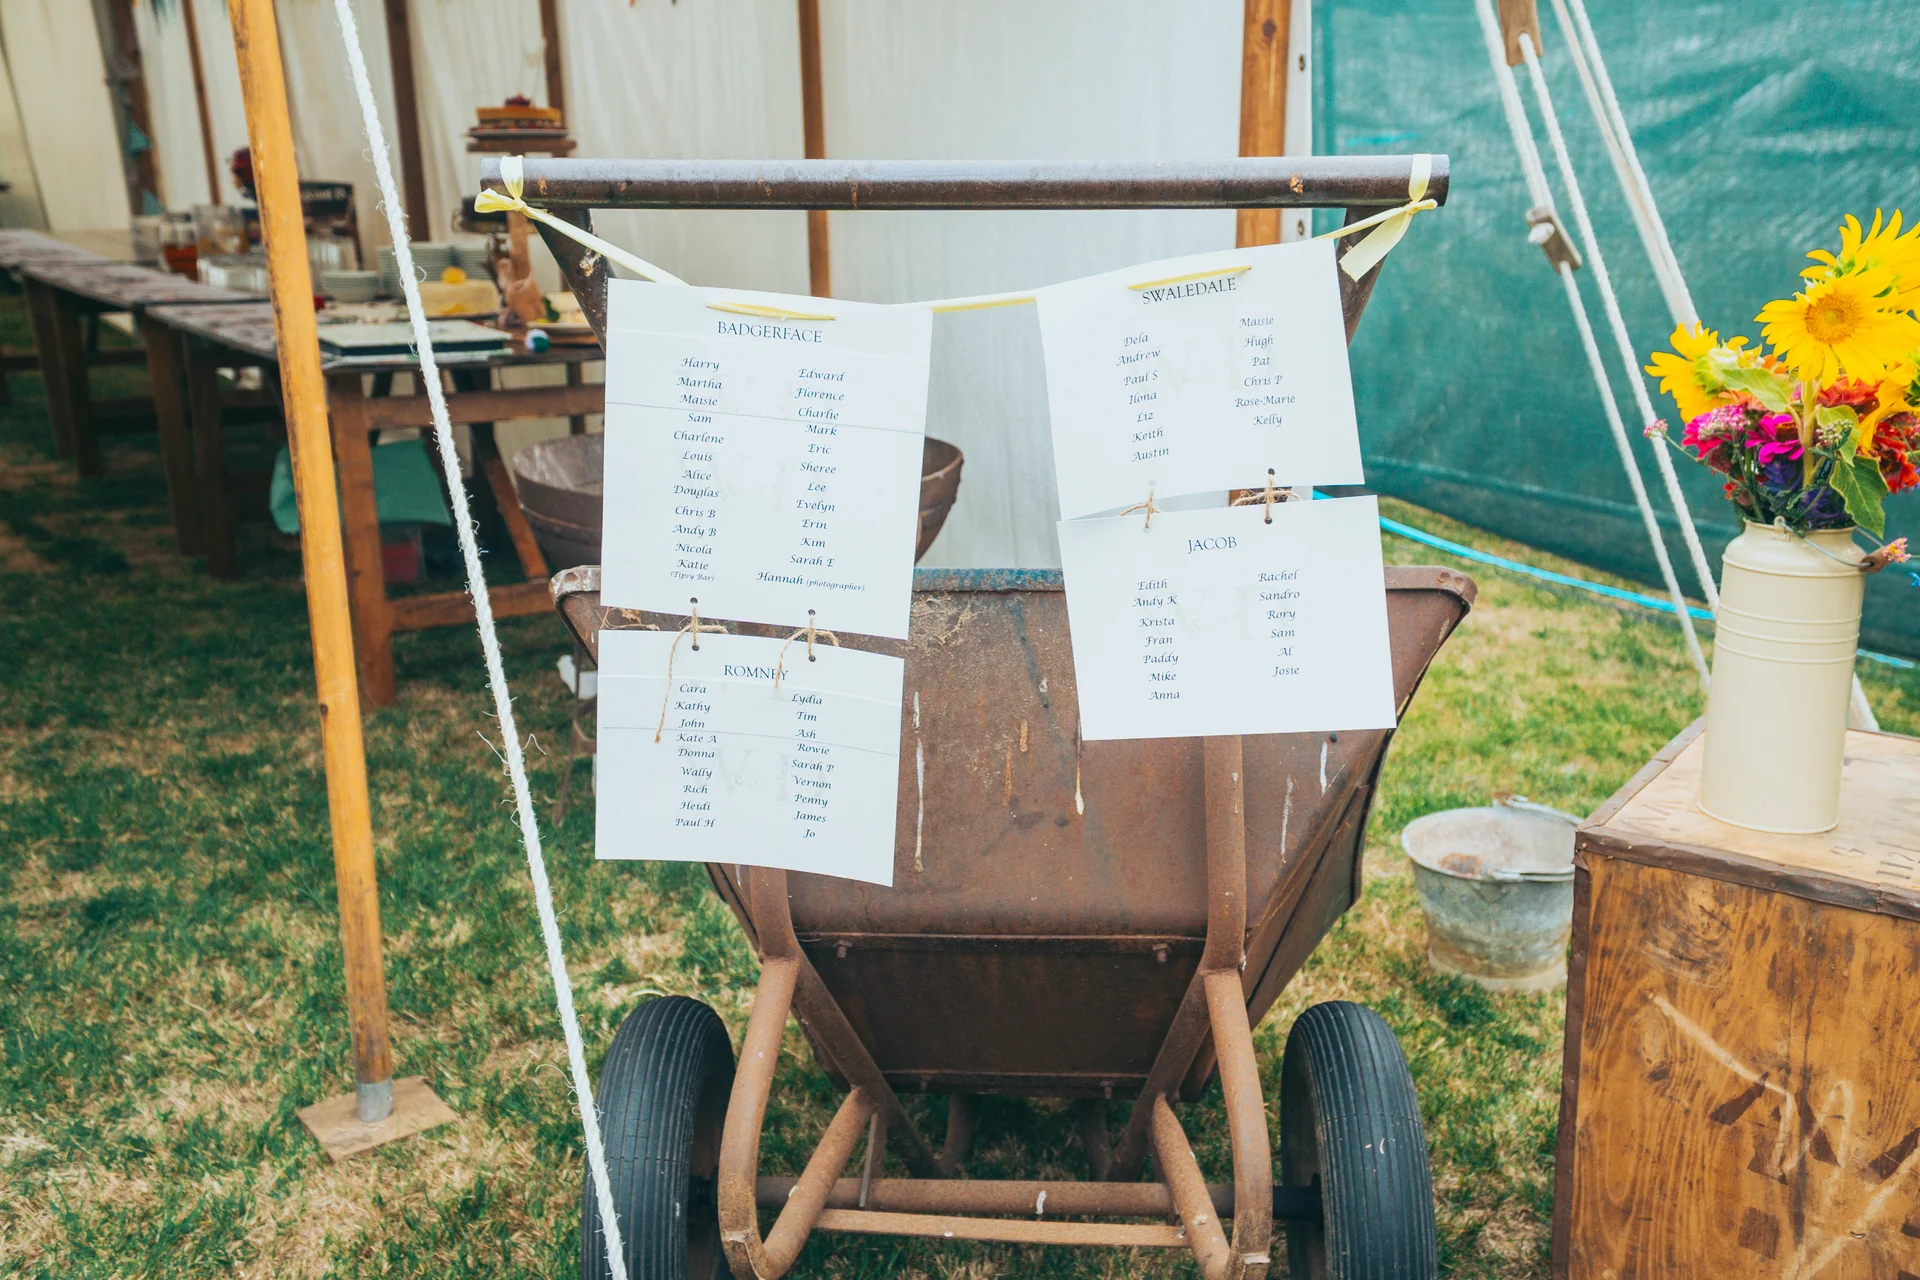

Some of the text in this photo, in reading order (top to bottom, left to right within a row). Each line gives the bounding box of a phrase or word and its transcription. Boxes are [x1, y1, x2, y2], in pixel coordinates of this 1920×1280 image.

[1142, 277, 1237, 305] SWALEDALE
[1239, 316, 1273, 327] Maisie
[719, 320, 823, 343] BADGERFACE
[1124, 332, 1148, 347] Dela
[1244, 334, 1273, 349] Hugh
[1117, 350, 1160, 366] Andrew
[1252, 357, 1270, 366] Pat
[681, 357, 719, 372] Harry
[798, 369, 846, 381] Edward
[1124, 371, 1157, 386] Paul S
[677, 377, 721, 389] Martha
[1244, 375, 1282, 387] Chris P
[679, 394, 717, 405] Maisie
[795, 388, 844, 401] Florence
[1129, 393, 1156, 404] Ilona
[1235, 394, 1295, 407] Rose-Marie
[688, 413, 711, 423] Sam
[799, 407, 839, 419] Charlie
[1137, 412, 1153, 422] Liz
[1253, 413, 1282, 427] Kelly
[805, 425, 837, 435] Mark
[1133, 427, 1163, 442] Keith
[674, 430, 724, 444] Charlene
[808, 444, 831, 454] Eric
[683, 451, 712, 461] Louis
[1132, 448, 1169, 462] Austin
[800, 462, 836, 474] Sheree
[682, 470, 711, 480] Alice
[674, 485, 719, 499] Douglas
[807, 482, 826, 491] Lee
[675, 506, 715, 518] Chris B
[797, 500, 835, 513] Evelyn
[802, 519, 826, 529] Erin
[672, 525, 716, 538] Andy B
[801, 538, 825, 547] Kim
[1187, 536, 1237, 554] JACOB
[675, 544, 711, 554] Nicola
[677, 559, 708, 570] Katie
[790, 555, 835, 567] Sarah E
[671, 571, 694, 581] (Tipsy
[1258, 569, 1299, 582] Rachel
[757, 572, 865, 591] Hannah (photographer)
[1138, 579, 1167, 590] Edith
[1260, 589, 1300, 601] Sandro
[1132, 596, 1177, 608] Andy K
[1267, 610, 1295, 621] Rory
[1139, 618, 1174, 627] Krista
[1271, 629, 1294, 638] Sam
[1145, 637, 1172, 647] Fran
[1278, 646, 1294, 656] Al
[1143, 653, 1178, 665] Paddy
[1149, 671, 1176, 681] Mike
[1272, 666, 1299, 677] Josie
[680, 684, 706, 693] Cara
[792, 694, 822, 705] Lydia
[1149, 692, 1179, 700] Anna
[674, 701, 710, 714] Kathy
[797, 712, 816, 721] Tim
[678, 719, 704, 728] John
[676, 734, 716, 743] Kate A
[795, 729, 816, 739] Ash
[678, 749, 714, 758] Donna
[797, 744, 829, 755] Rowie
[792, 760, 834, 772] Sarah P
[682, 767, 712, 780] Wally
[794, 775, 831, 789] Vernon
[683, 785, 707, 793] Rich
[680, 801, 710, 810] Heidi
[795, 794, 828, 808] Penny
[793, 811, 826, 822] James
[675, 818, 716, 827] Paul H
[803, 829, 815, 838] Jo
